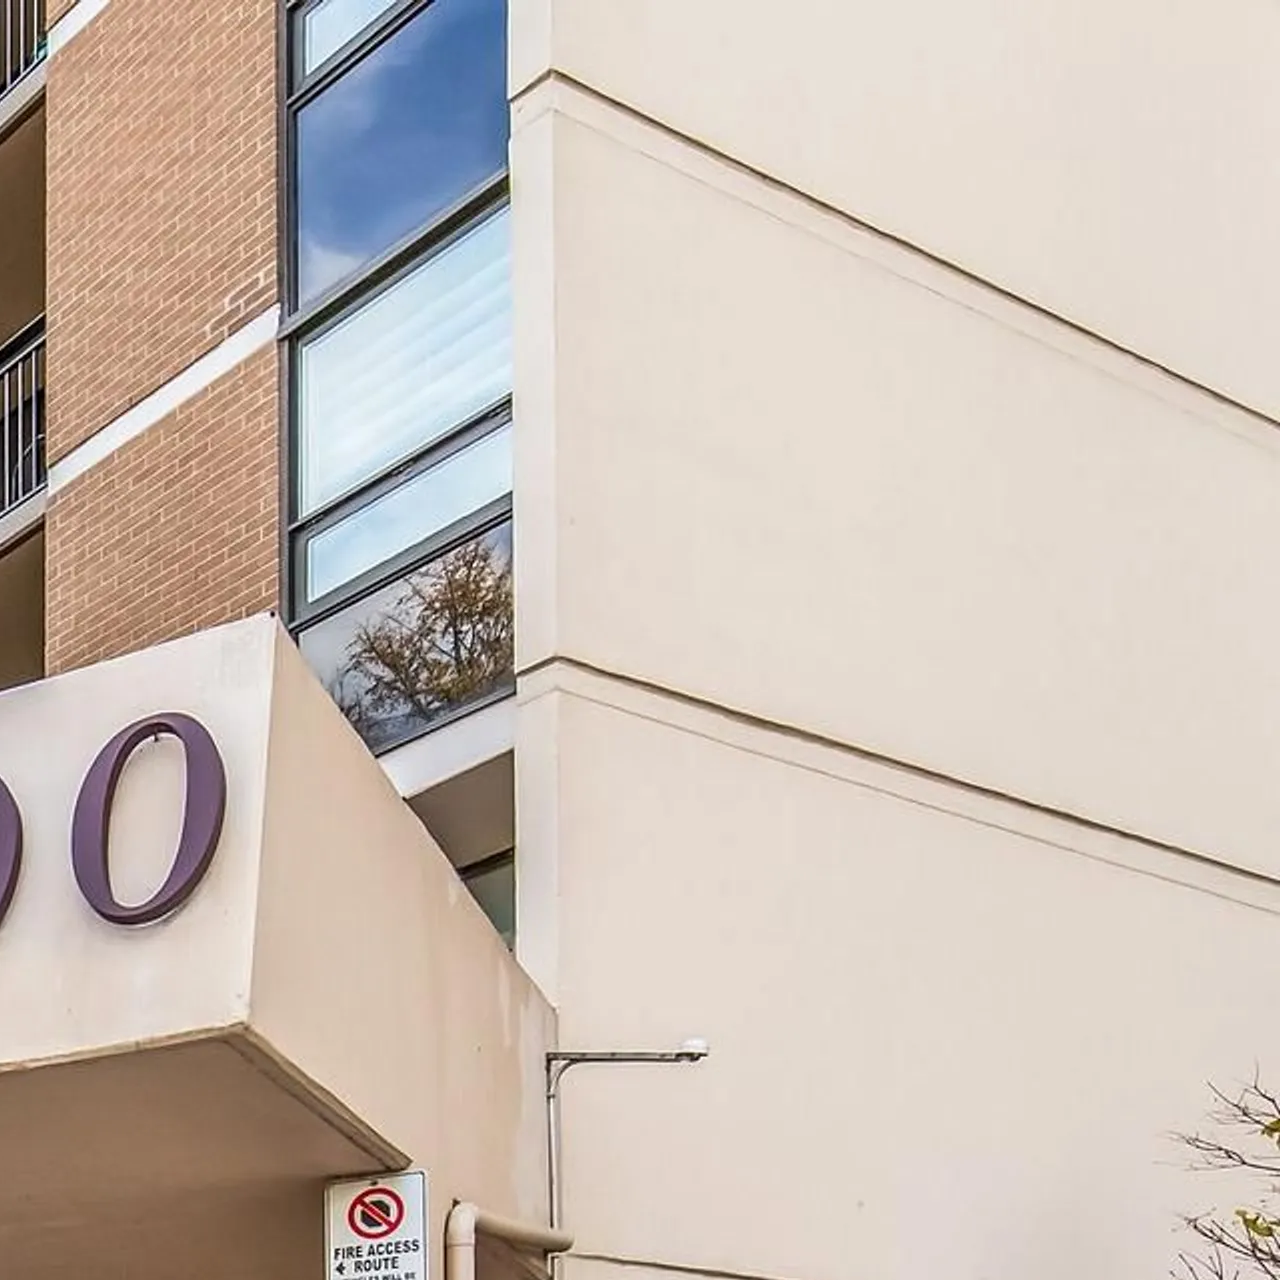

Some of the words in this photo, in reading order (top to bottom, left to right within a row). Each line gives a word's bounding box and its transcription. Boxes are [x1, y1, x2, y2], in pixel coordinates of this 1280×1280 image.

[334, 1246, 363, 1260] FIRE
[367, 1240, 420, 1257] ACCESS
[354, 1256, 399, 1273] ROUTE
[404, 1272, 416, 1280] BE
